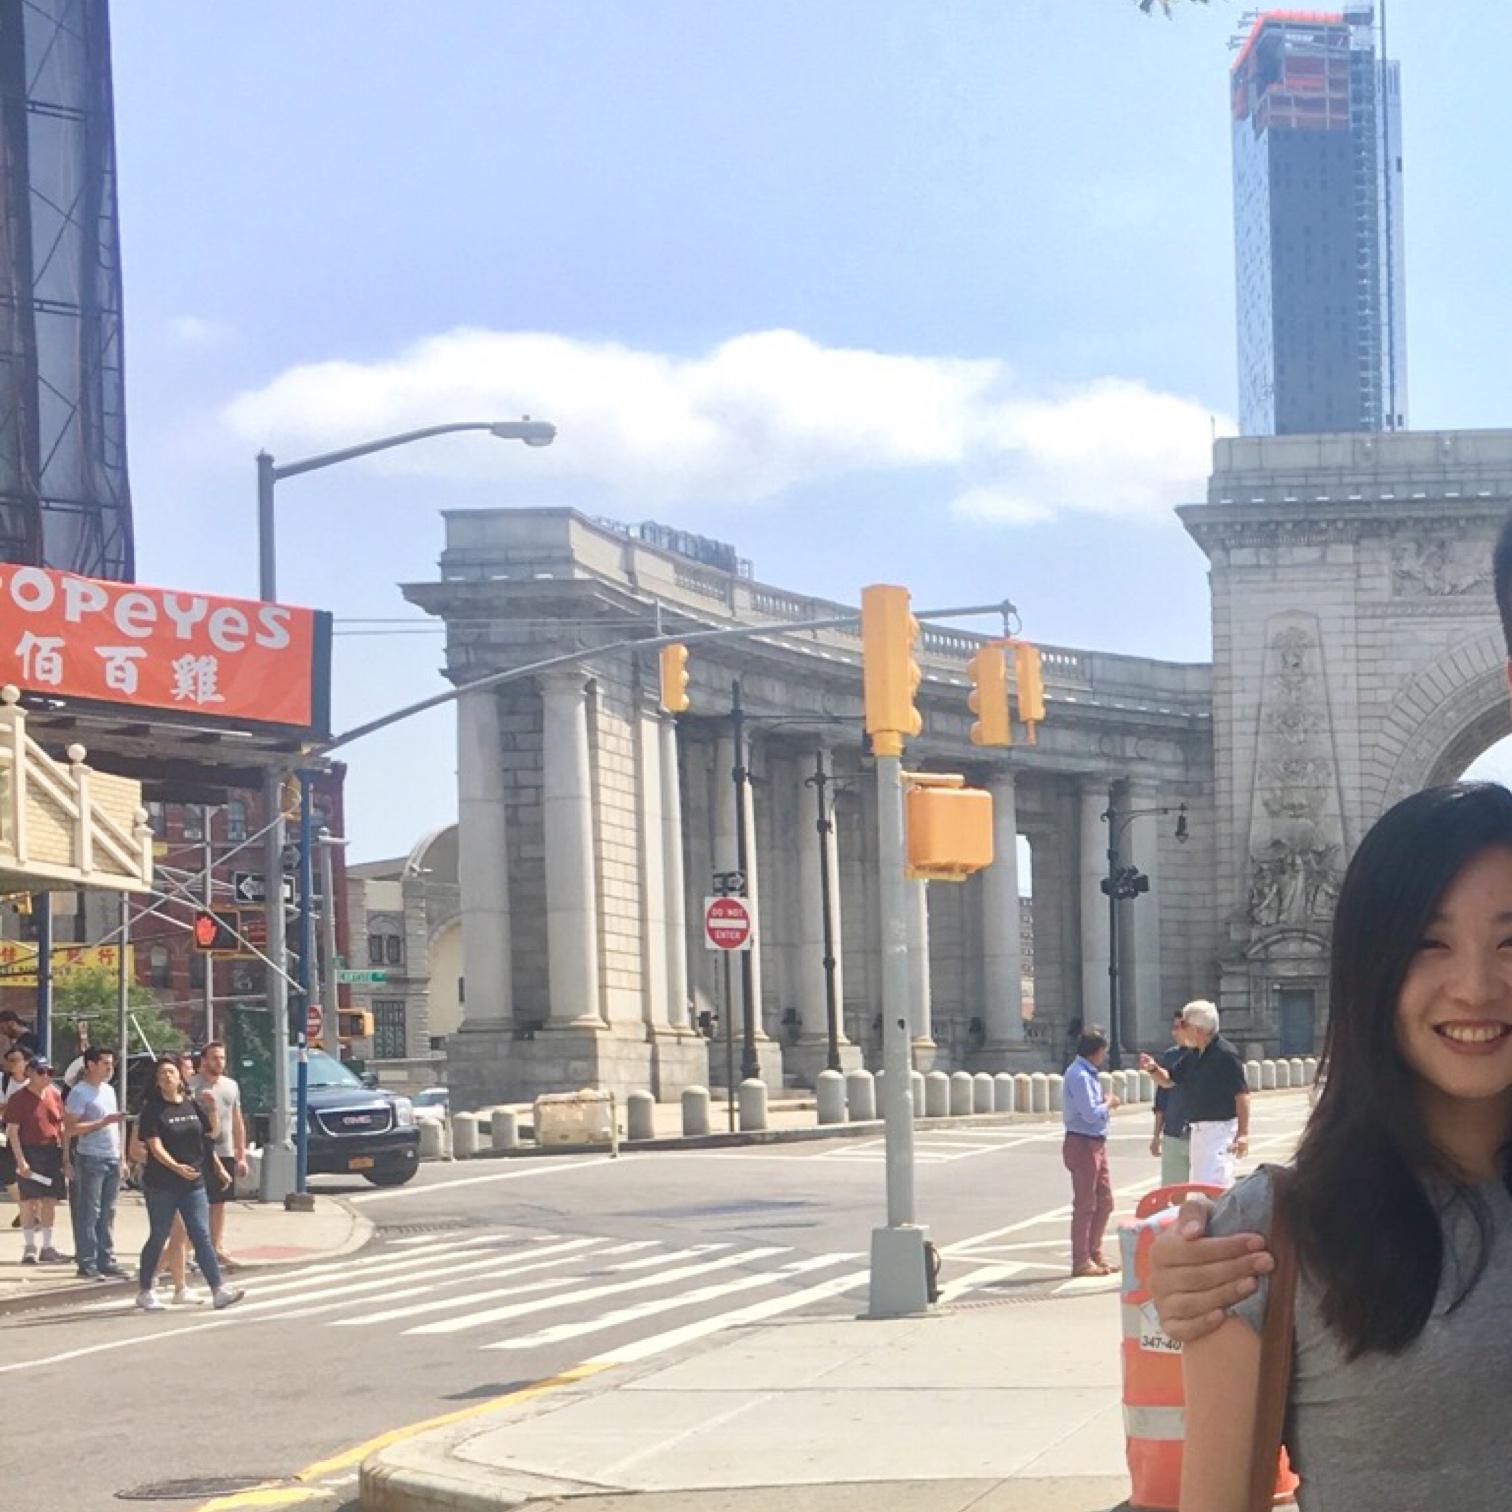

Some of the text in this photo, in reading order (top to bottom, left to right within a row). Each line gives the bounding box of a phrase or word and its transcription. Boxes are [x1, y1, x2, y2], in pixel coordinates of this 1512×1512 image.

[0, 566, 291, 652] OPeYeS
[710, 908, 744, 918] DO NOT
[715, 929, 741, 940] ENTER
